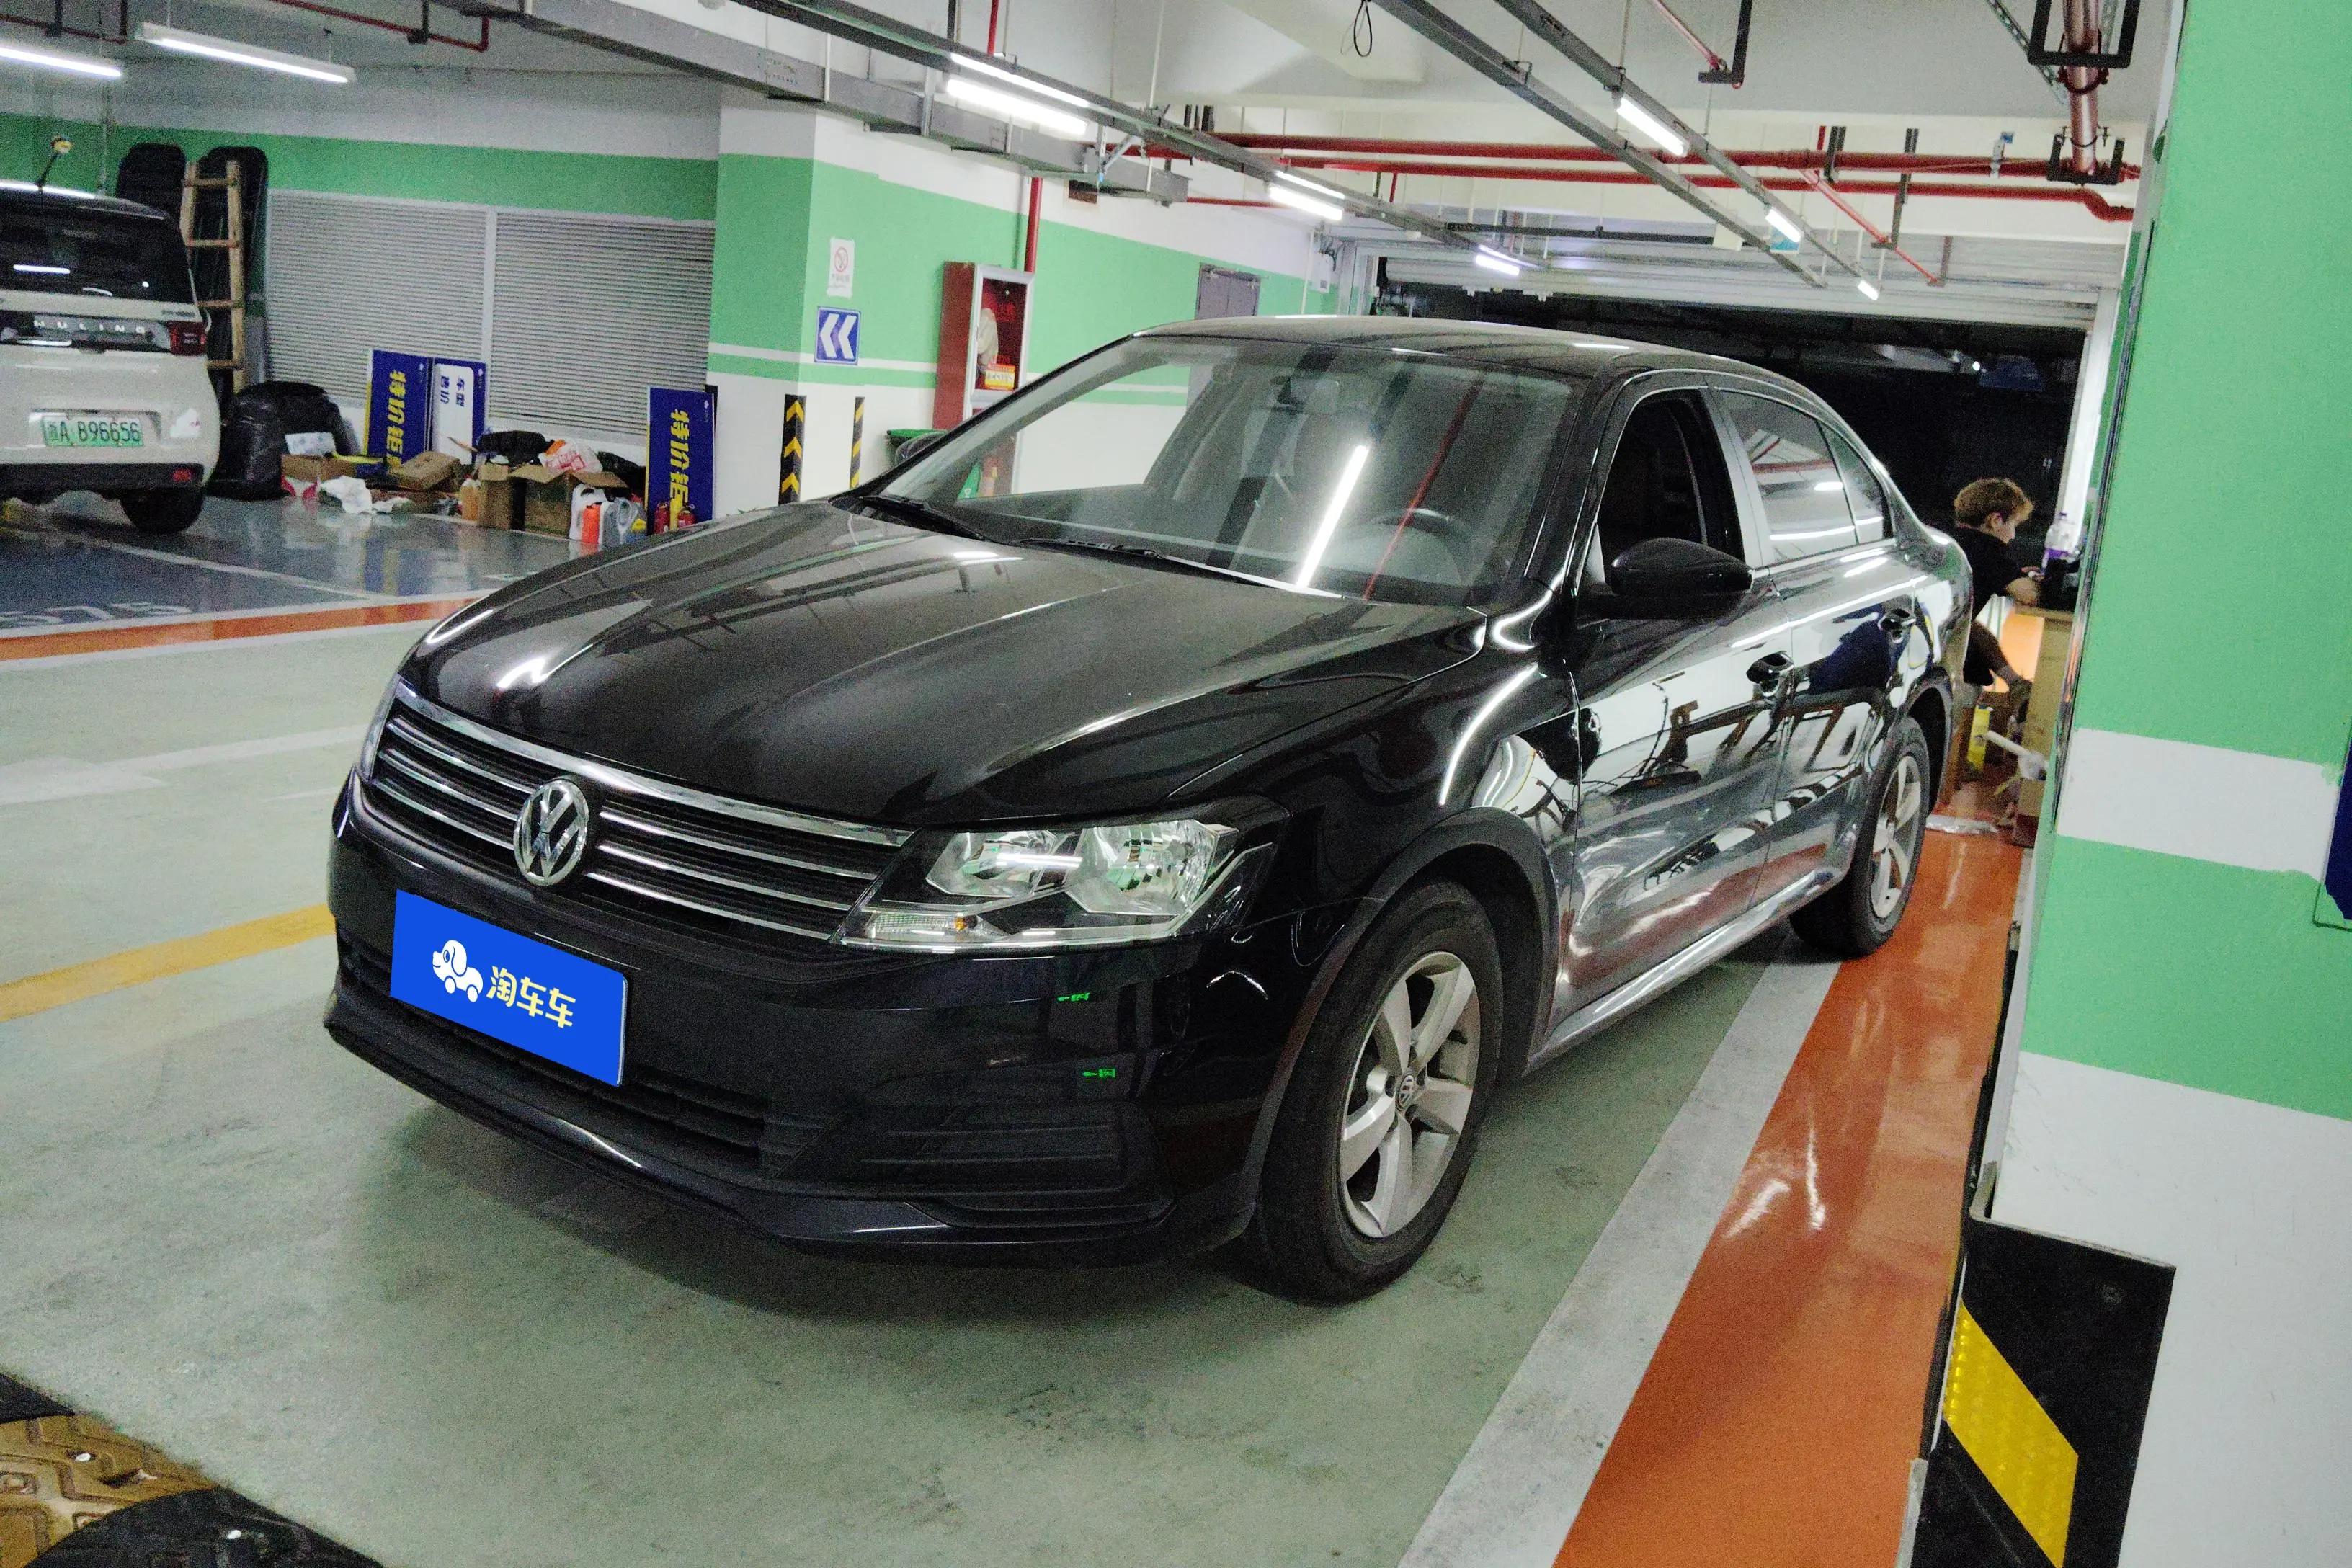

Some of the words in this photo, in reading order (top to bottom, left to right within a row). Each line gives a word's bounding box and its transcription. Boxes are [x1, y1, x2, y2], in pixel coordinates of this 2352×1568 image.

[455, 378, 466, 408] 车型
[669, 409, 690, 528] 特价钜
